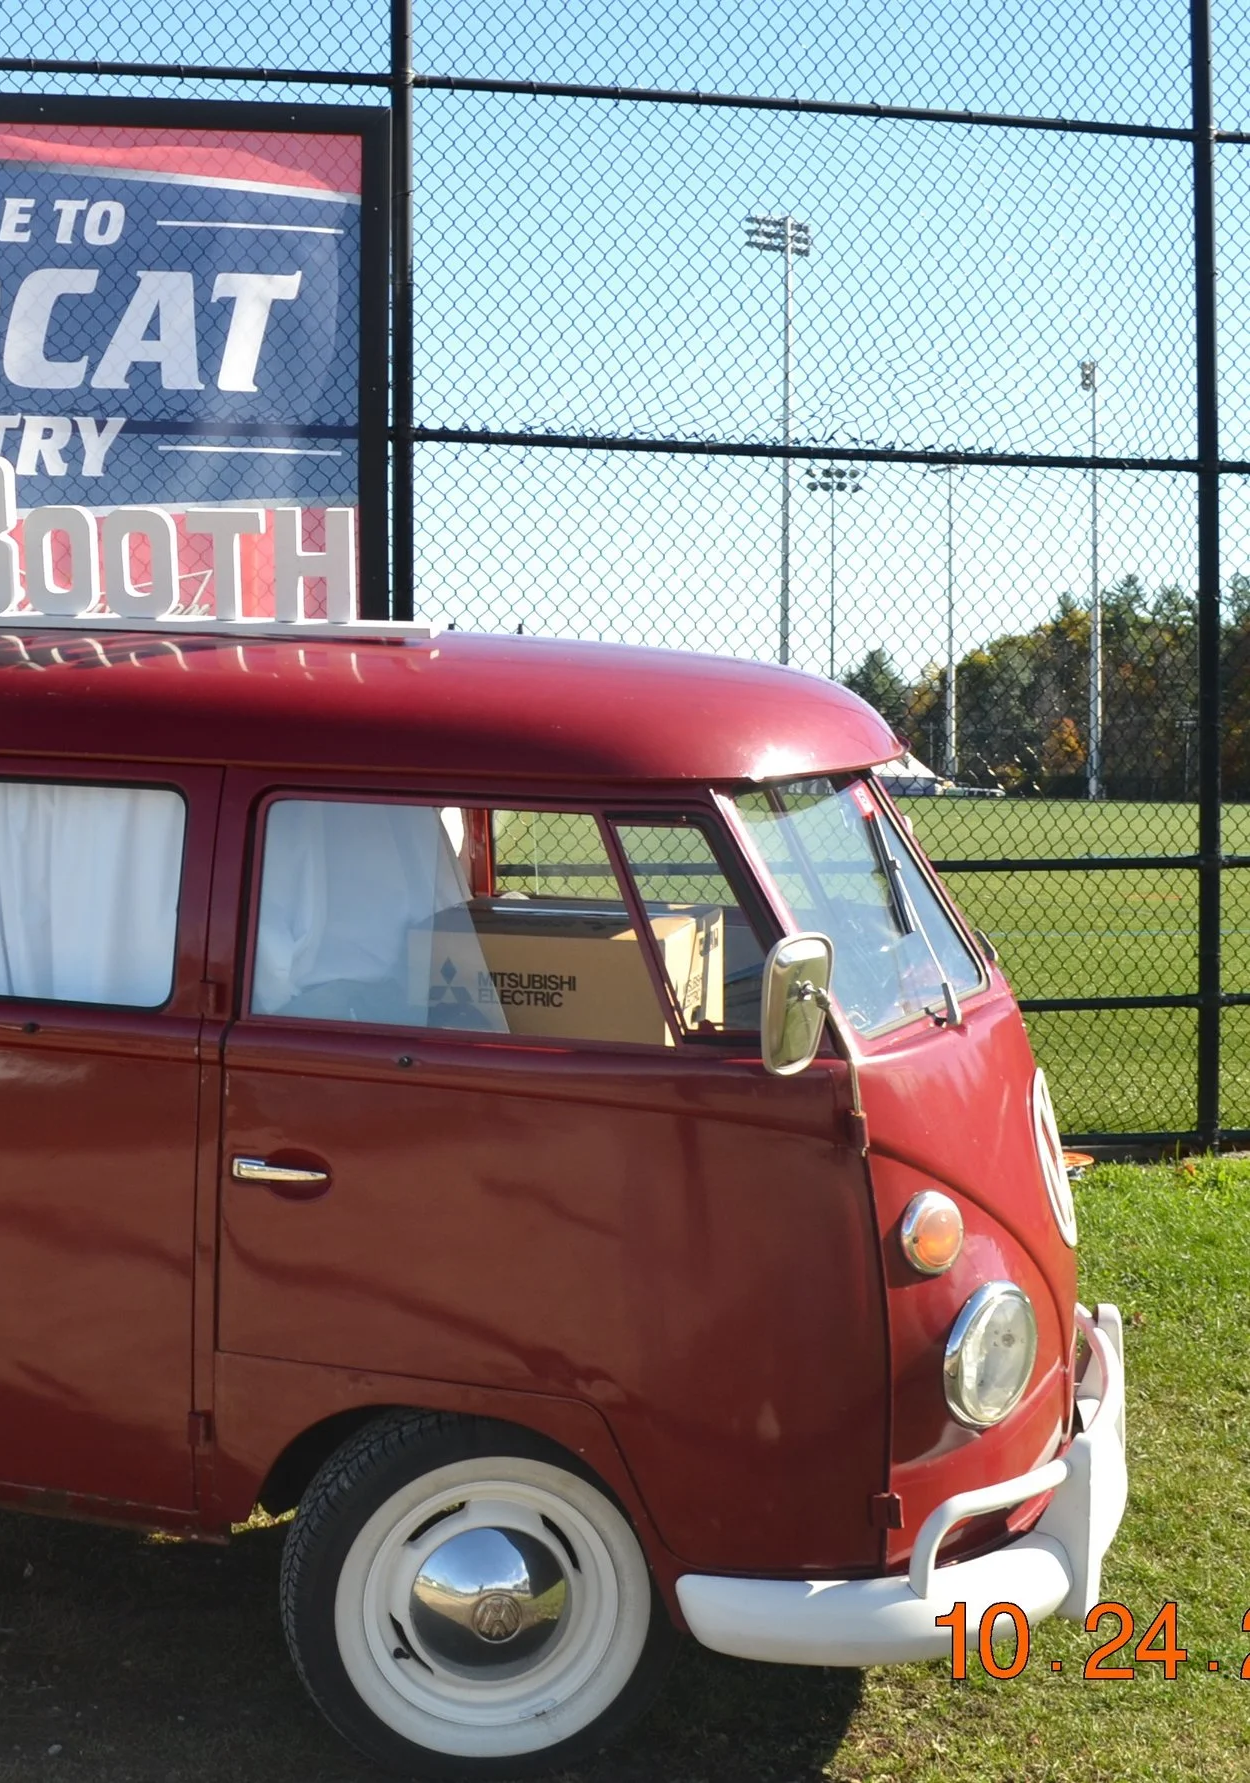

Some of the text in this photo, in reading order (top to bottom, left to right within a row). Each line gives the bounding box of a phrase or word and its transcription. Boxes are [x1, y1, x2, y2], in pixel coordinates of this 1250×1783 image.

[53, 199, 125, 246] TO
[477, 970, 577, 992] MITSUBISHI
[478, 988, 564, 1008] ELECTRIC
